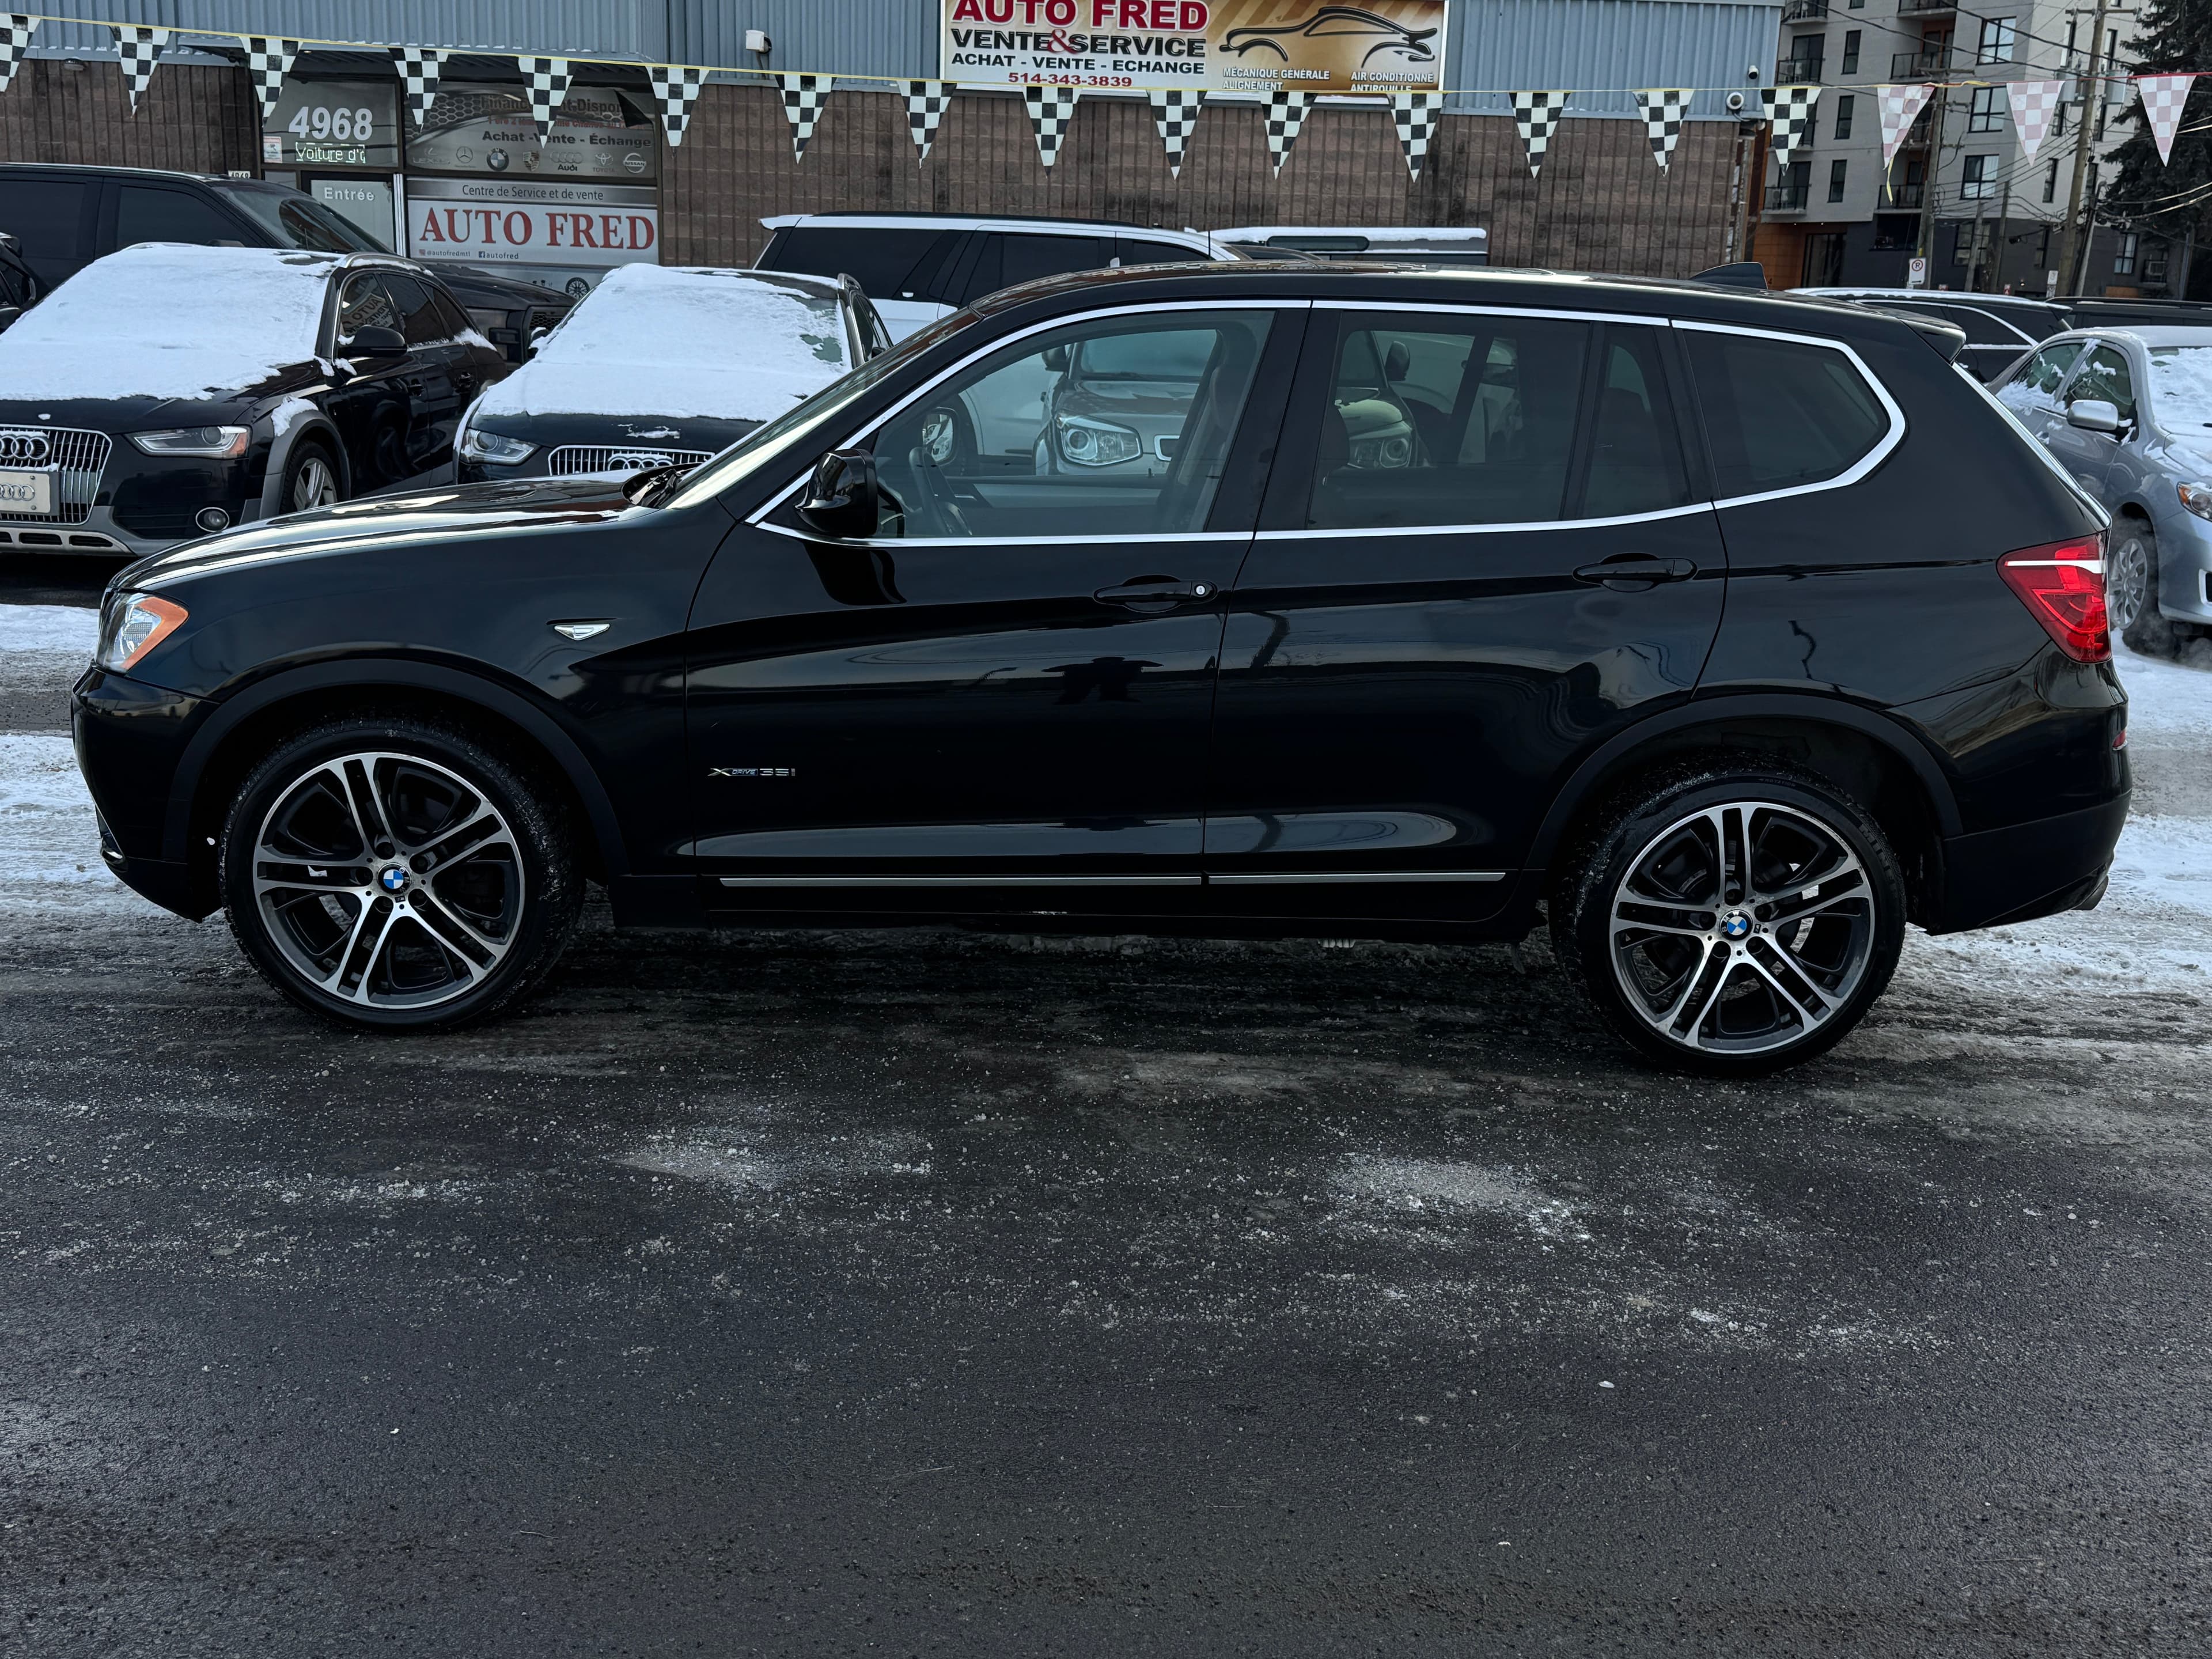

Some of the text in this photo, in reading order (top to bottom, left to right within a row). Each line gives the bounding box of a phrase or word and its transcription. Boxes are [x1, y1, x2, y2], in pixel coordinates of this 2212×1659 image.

[951, 0, 1209, 31] AUTO FRED
[952, 52, 1016, 67] ACHAT
[1032, 56, 1095, 70] VENTE
[1112, 60, 1205, 74] ECHANGE
[1008, 72, 1132, 87] 514-343-3839
[1222, 66, 1331, 80] MÉCANIQUE GÉNÉRALE
[1351, 71, 1367, 81] AIR
[1222, 79, 1283, 90] ALIGNEMENT
[289, 106, 373, 141] 4968
[482, 131, 525, 142] Achat
[589, 133, 652, 149] Échange
[296, 147, 343, 161] Voiture
[324, 187, 374, 201] Entrée
[463, 184, 604, 200] Centre de Service et de vente
[419, 207, 655, 250] AUTO FRED
